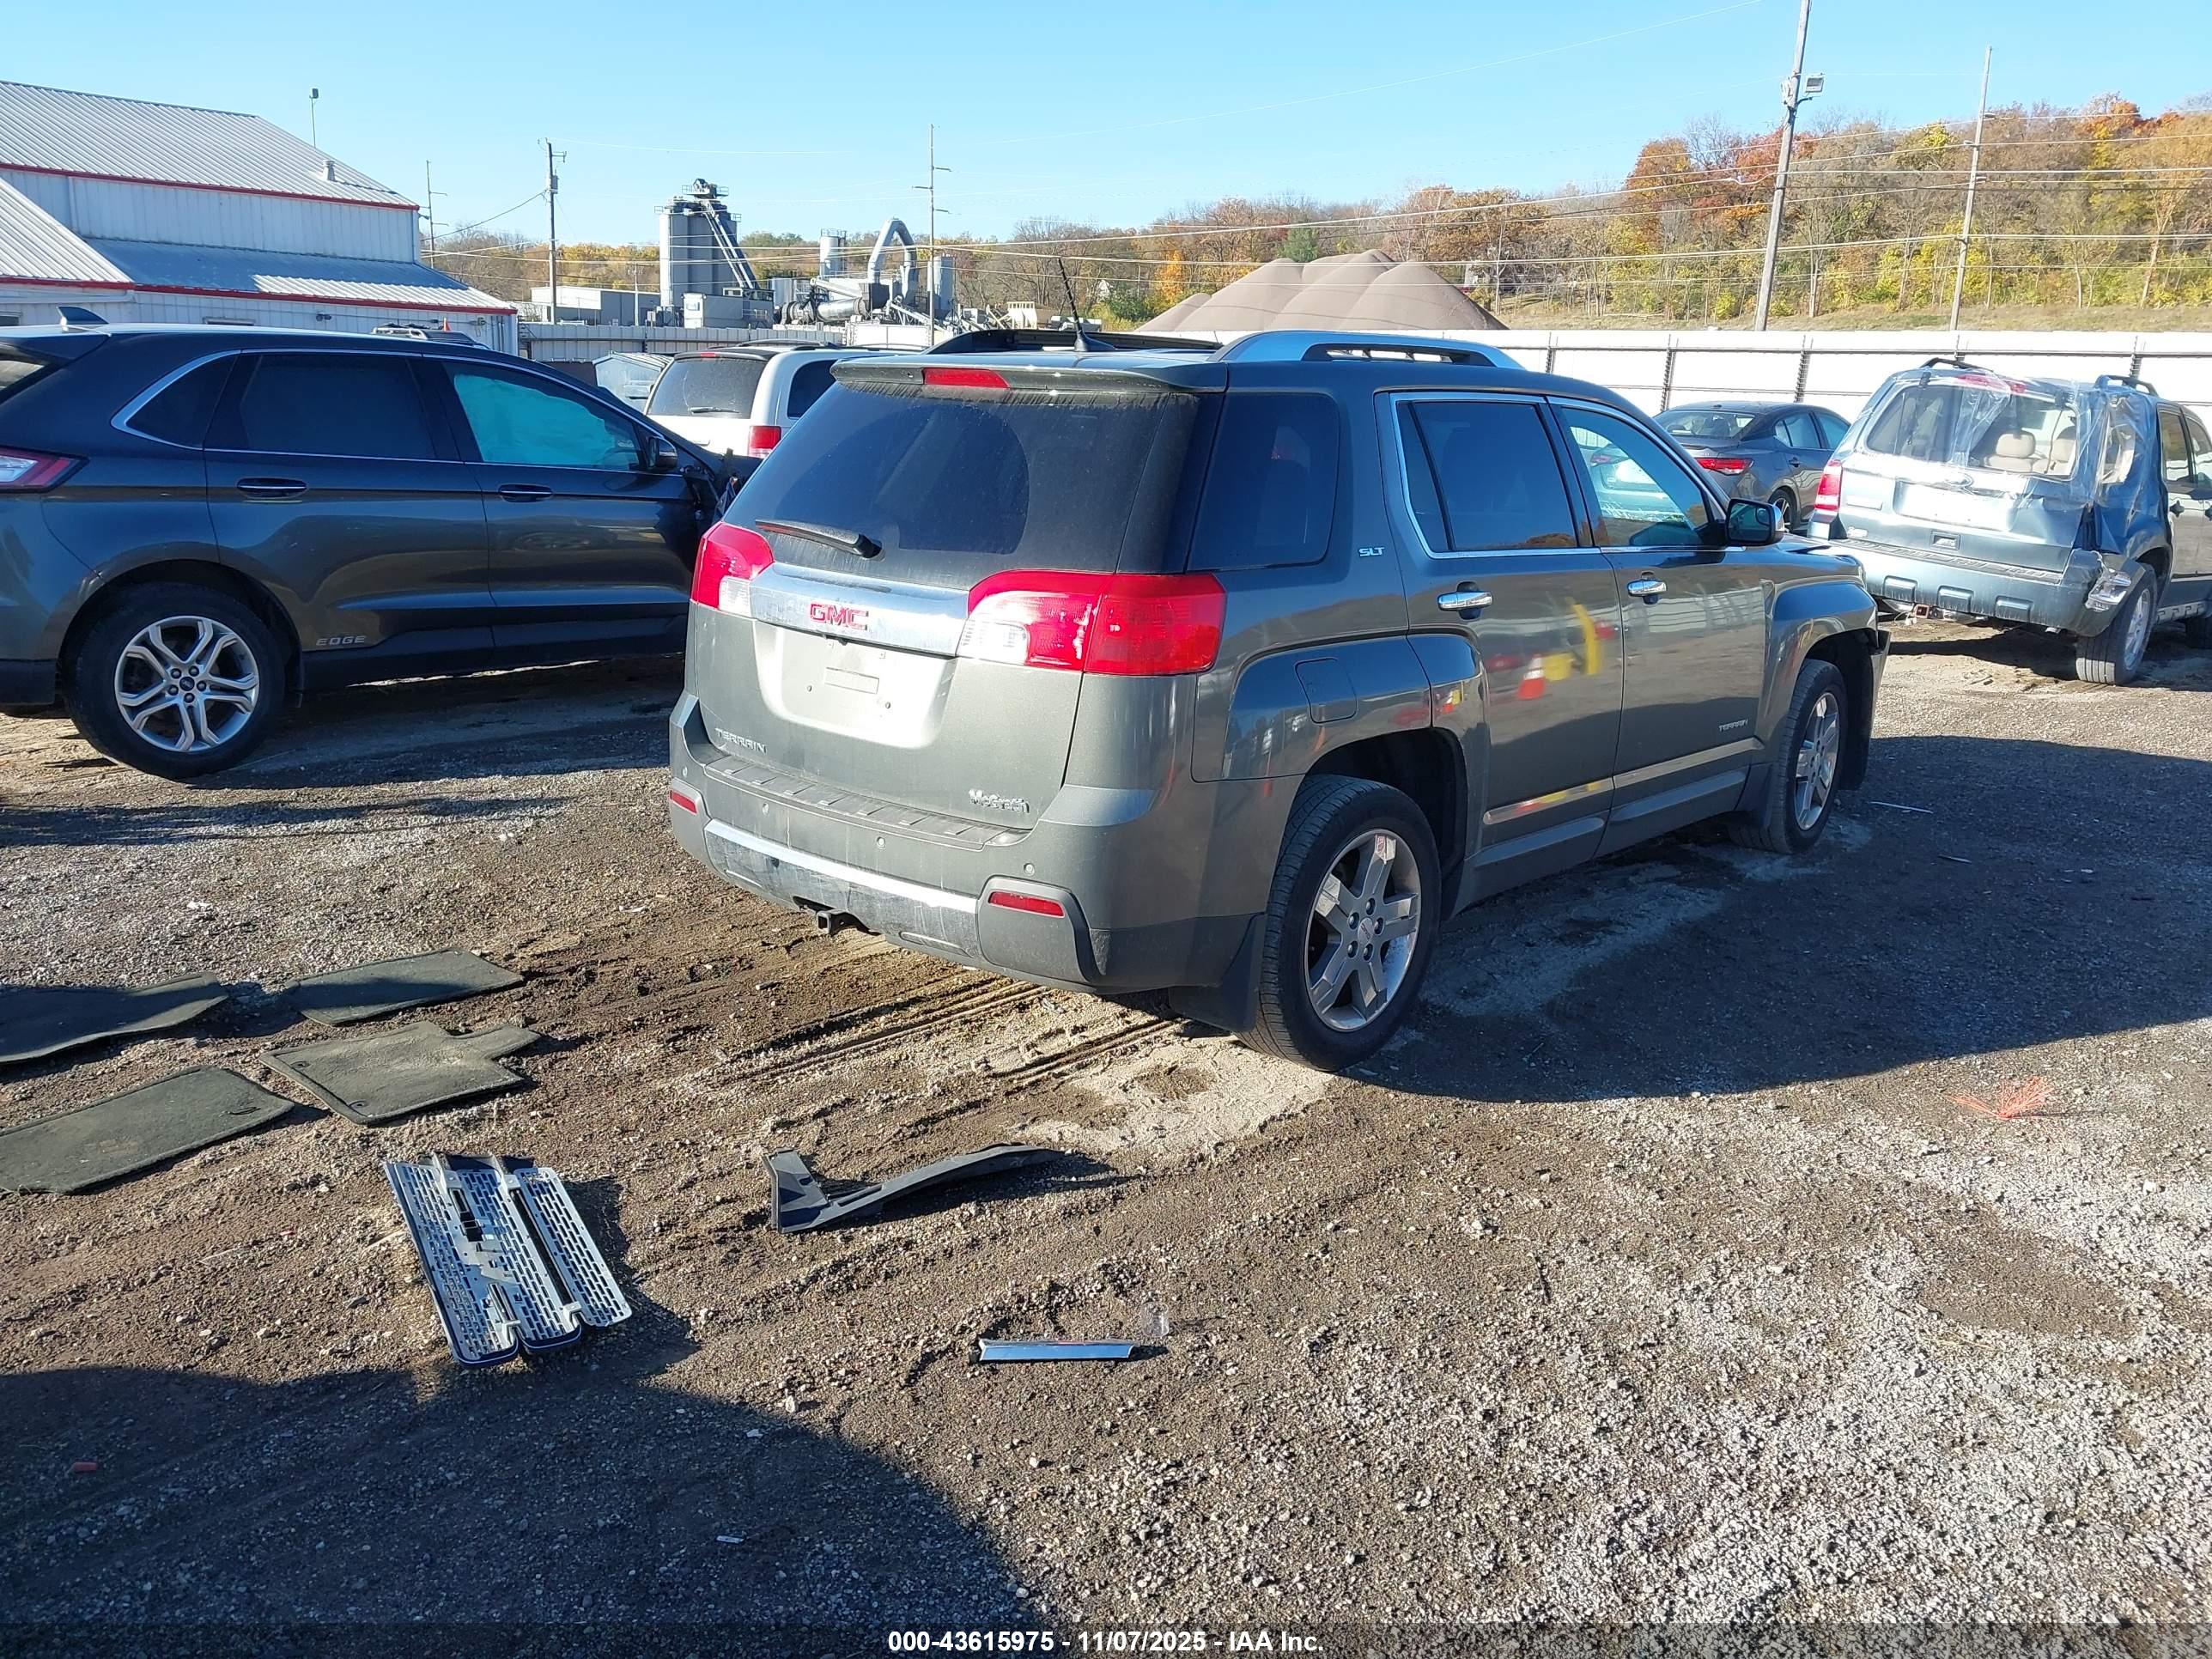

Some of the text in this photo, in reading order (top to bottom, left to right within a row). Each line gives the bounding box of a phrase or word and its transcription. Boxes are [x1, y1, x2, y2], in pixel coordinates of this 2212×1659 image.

[1358, 546, 1385, 556] SLT
[810, 604, 869, 631] GMC
[315, 635, 367, 647] EDGE
[714, 727, 767, 755] TERRAIN
